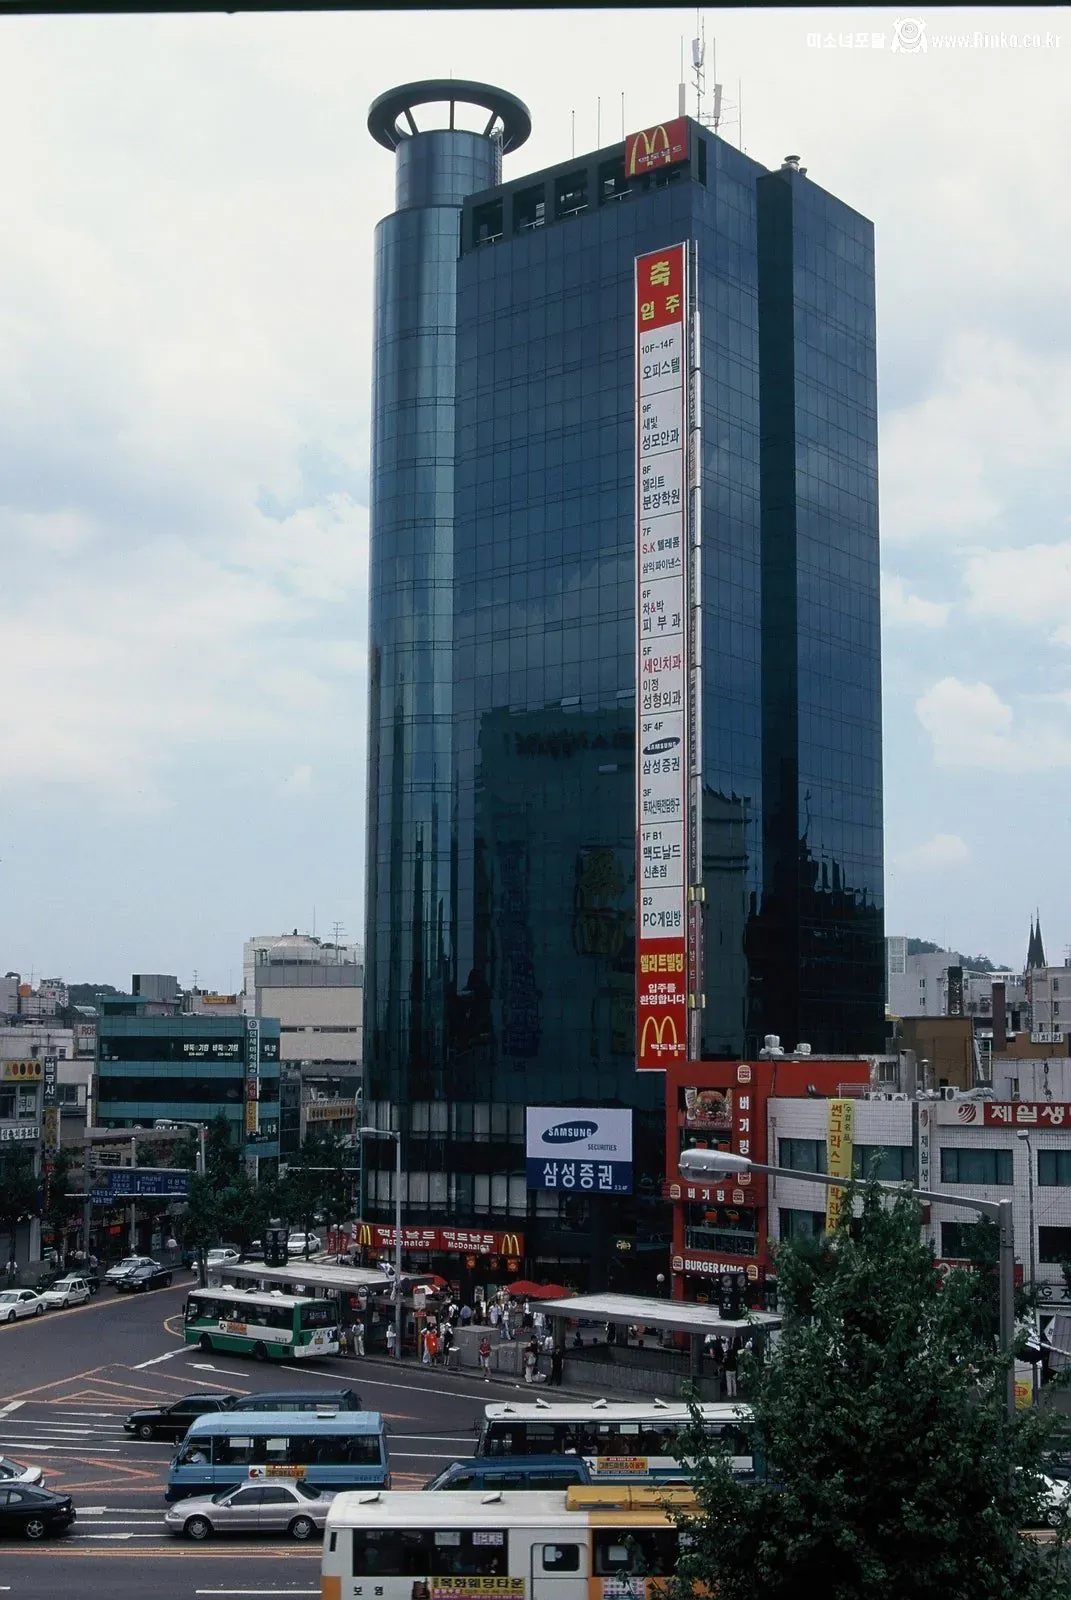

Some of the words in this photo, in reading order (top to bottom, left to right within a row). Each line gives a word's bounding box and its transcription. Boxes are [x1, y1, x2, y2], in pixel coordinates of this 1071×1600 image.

[650, 261, 670, 286] 축
[643, 357, 680, 380] 오피스텔
[642, 404, 652, 413] 9F
[642, 416, 658, 430] 새빛
[642, 428, 680, 451] 성모안과
[642, 465, 651, 474] 8F
[642, 476, 665, 492] 엘리트
[642, 488, 680, 510] 분장학원
[642, 527, 651, 536] 7F
[642, 590, 651, 598] 6F
[642, 600, 664, 615] 차&박
[642, 646, 652, 656] 5F
[643, 654, 681, 673] 세인치과
[642, 678, 659, 692] 이정
[643, 690, 681, 710] 성형외과
[642, 724, 652, 733] 3F
[653, 721, 663, 731] 4F
[647, 741, 676, 751] SAMSUNG
[643, 757, 680, 775] 삼성증권
[642, 789, 652, 797] 3F
[642, 832, 651, 841] 1F
[652, 831, 662, 840] B1
[643, 844, 681, 861] 맥도날드
[643, 864, 667, 878] 신촌점
[642, 897, 653, 906] B2
[643, 910, 681, 927] PC게임방
[648, 983, 676, 994] 입주를
[640, 993, 685, 1005] 환영합니다
[45, 1062, 55, 1095] 법무사
[991, 1105, 1071, 1125] 제일생
[548, 1127, 592, 1137] SAMSUNG
[830, 1104, 842, 1164] 썬그라스
[587, 1143, 617, 1151] SECURITIES
[543, 1162, 612, 1190] 삼성증권
[377, 1228, 435, 1240] 맥도날드
[442, 1231, 494, 1244] 맥도날드
[685, 1259, 719, 1273] BURGER
